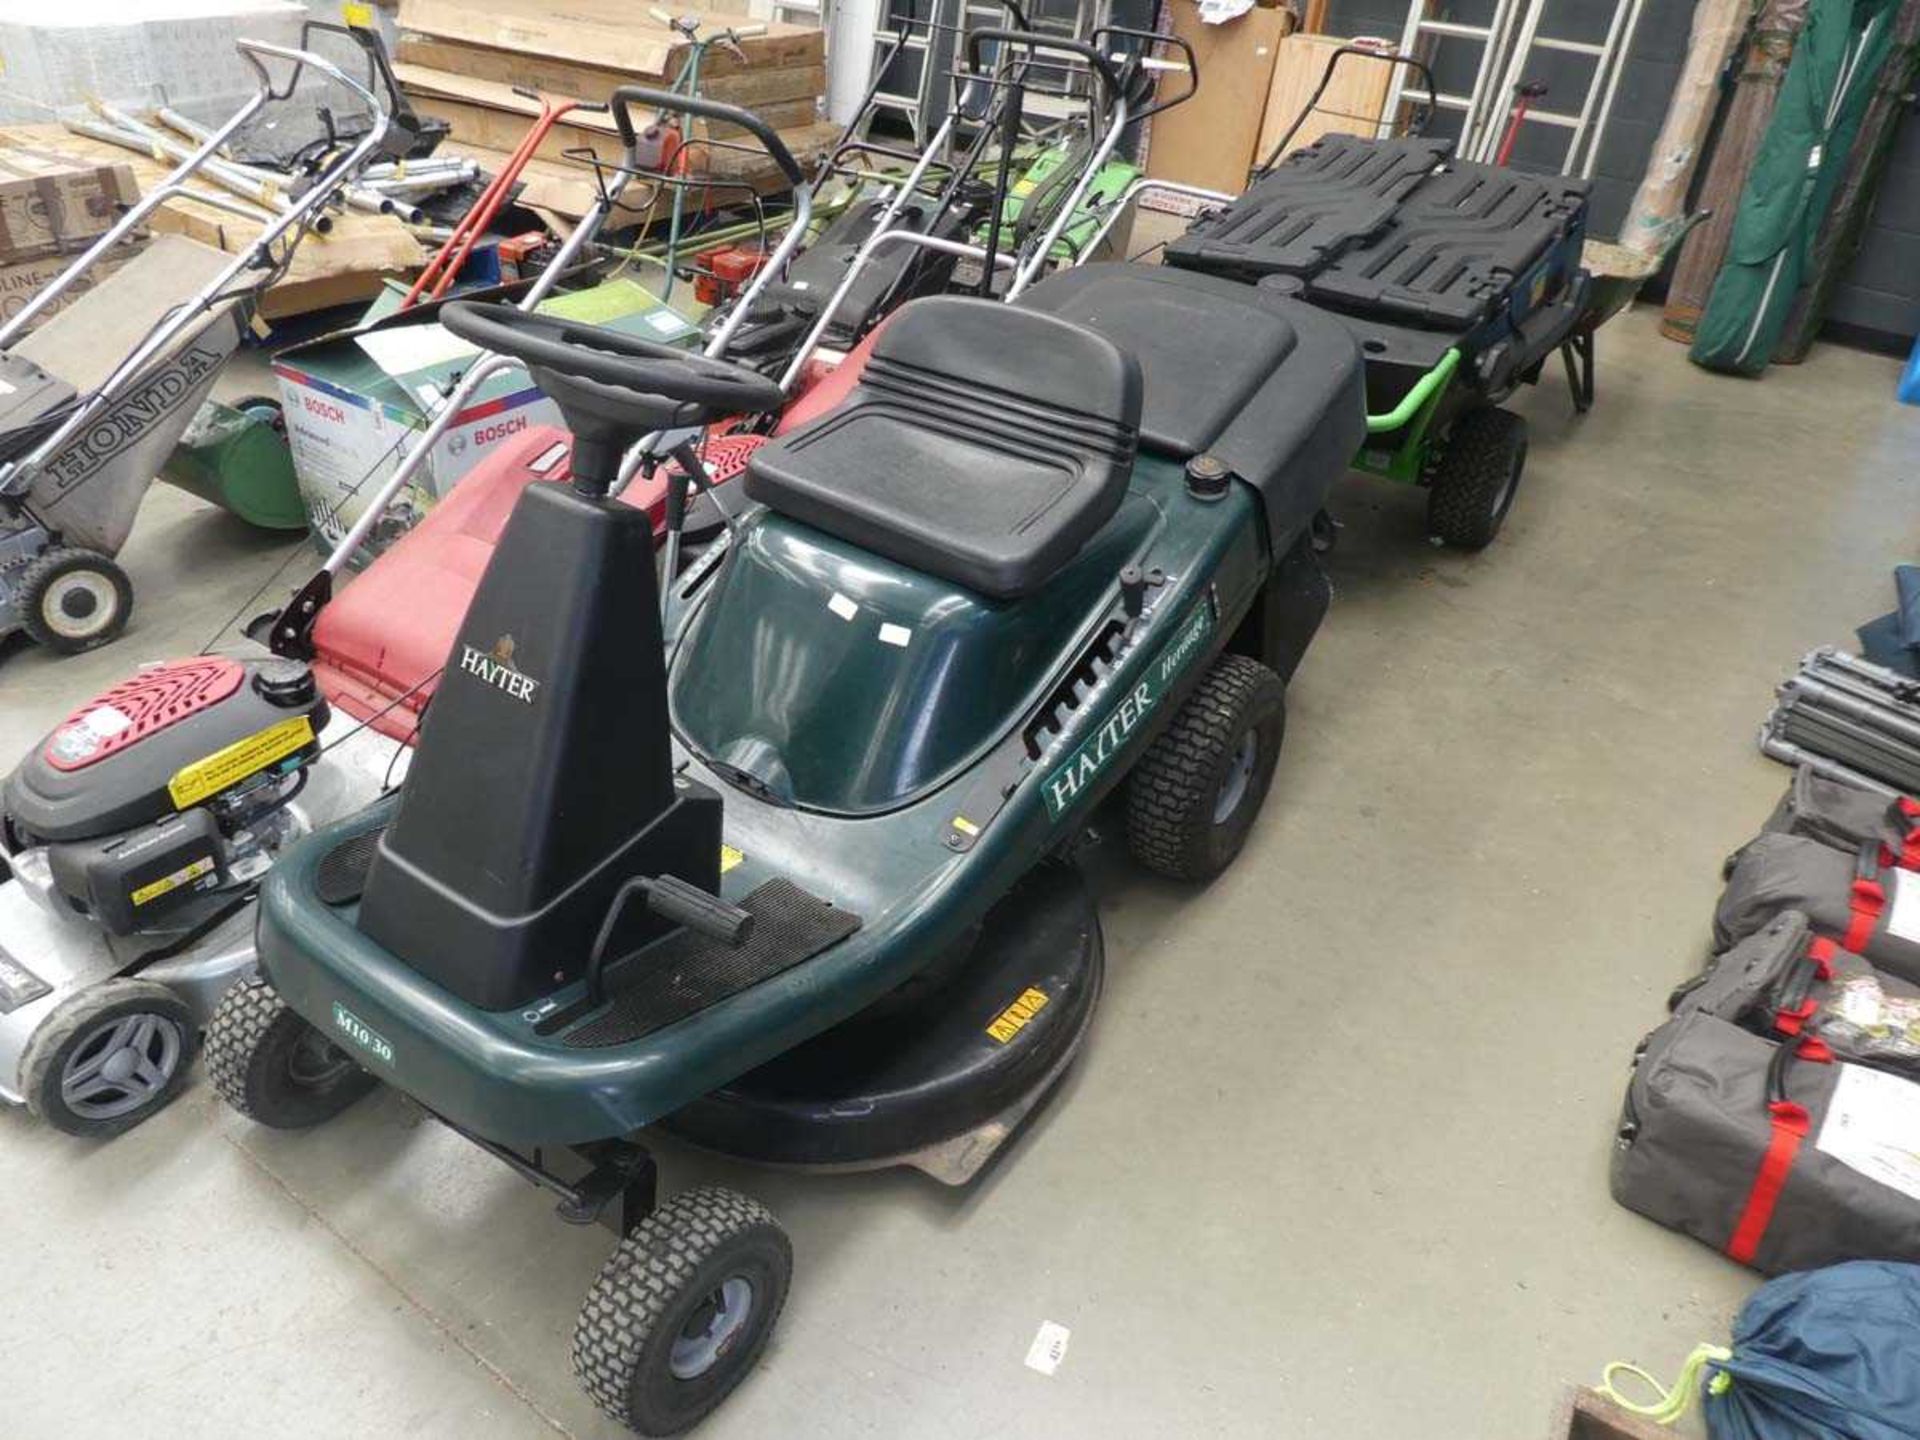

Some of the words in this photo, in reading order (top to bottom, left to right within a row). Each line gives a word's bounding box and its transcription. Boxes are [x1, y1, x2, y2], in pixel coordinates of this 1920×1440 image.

[45, 348, 223, 488] HONDA
[304, 396, 345, 425] BOSCH
[474, 415, 527, 446] BOSCH
[460, 645, 540, 704] HAYTER
[1051, 682, 1152, 811] HAYTER
